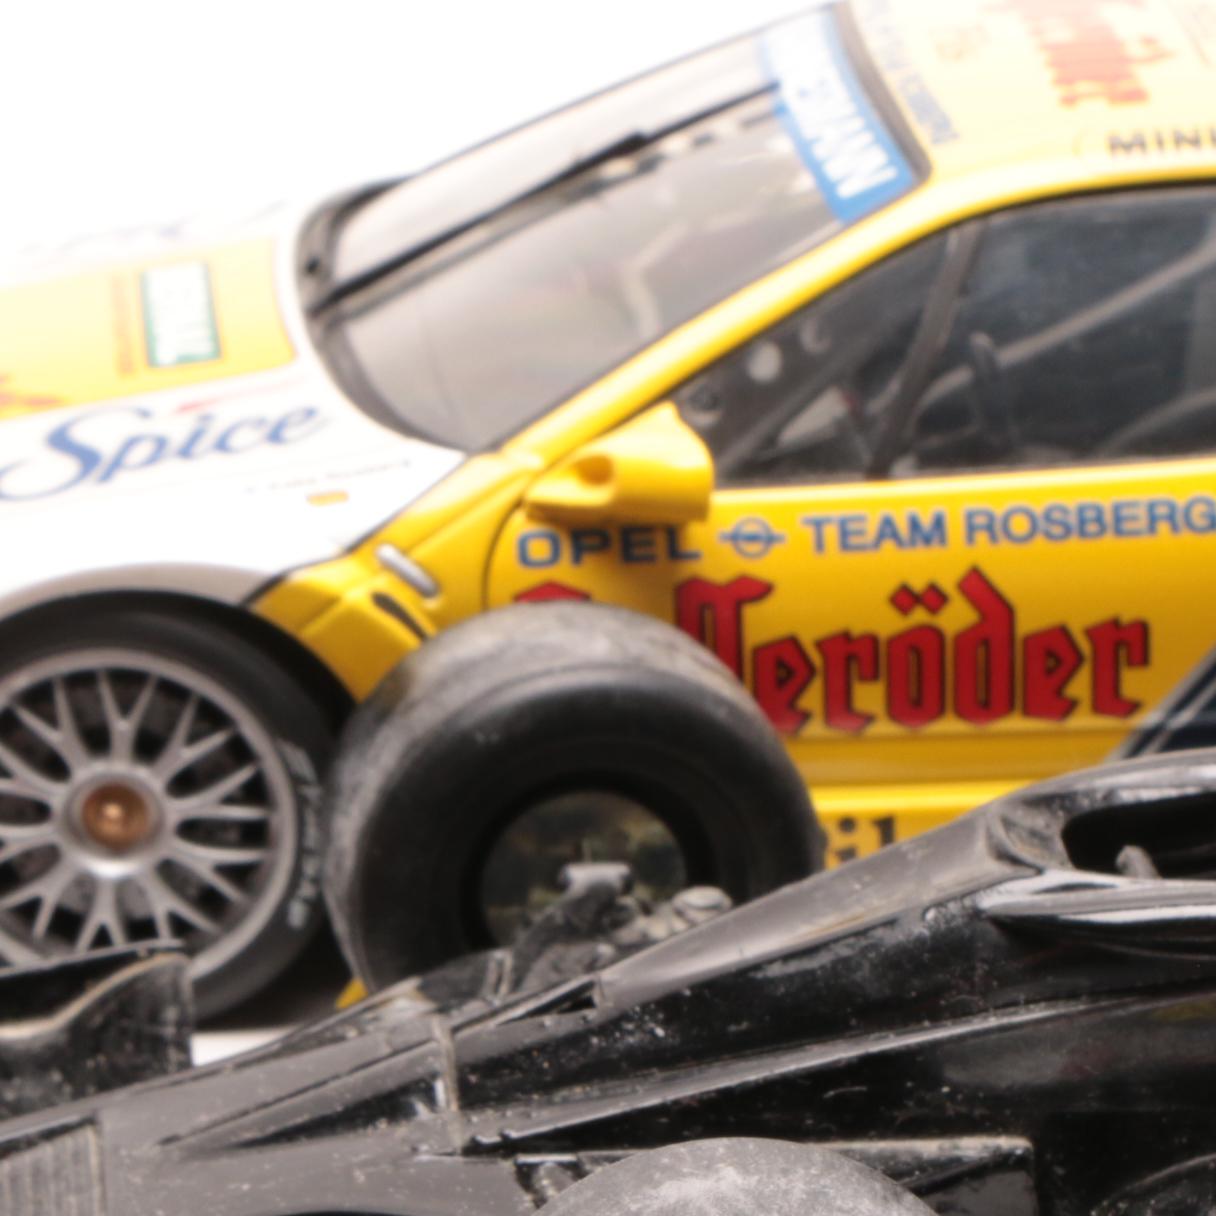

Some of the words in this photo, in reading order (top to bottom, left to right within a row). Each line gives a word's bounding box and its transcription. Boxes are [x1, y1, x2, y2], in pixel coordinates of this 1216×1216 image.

[0, 406, 332, 501] Spice
[517, 527, 704, 568] OPEL
[802, 511, 949, 555] TEAM
